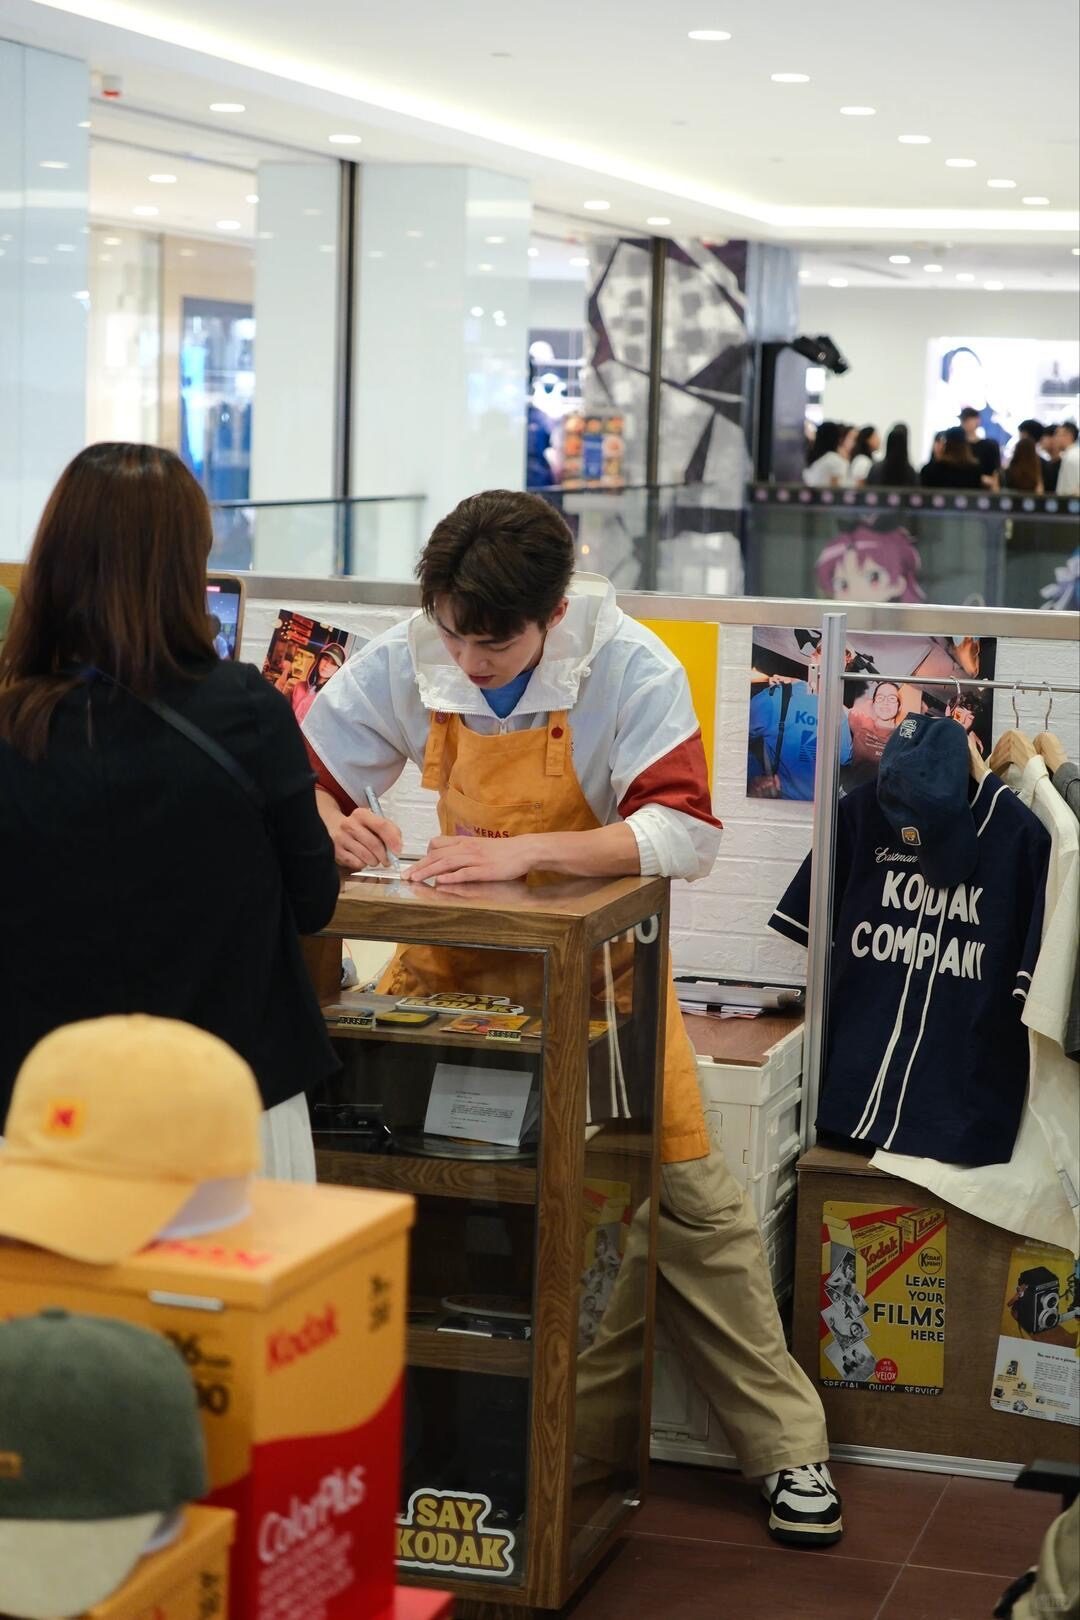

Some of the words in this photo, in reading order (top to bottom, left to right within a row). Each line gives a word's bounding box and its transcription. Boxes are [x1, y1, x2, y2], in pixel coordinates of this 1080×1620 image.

[795, 710, 817, 726] Ko
[875, 847, 919, 863] Eastman
[881, 870, 983, 926] KODAK
[404, 999, 515, 1013] KODAK
[860, 1236, 898, 1267] Kodak
[905, 1274, 945, 1289] LEAVE
[908, 1290, 944, 1305] YOUR
[873, 1303, 945, 1328] FILMS
[265, 1301, 339, 1374] Kodak
[911, 1329, 944, 1342] HERE
[875, 1371, 897, 1381] VELOX
[416, 1498, 482, 1531] SAY
[396, 1528, 506, 1568] KODAK
